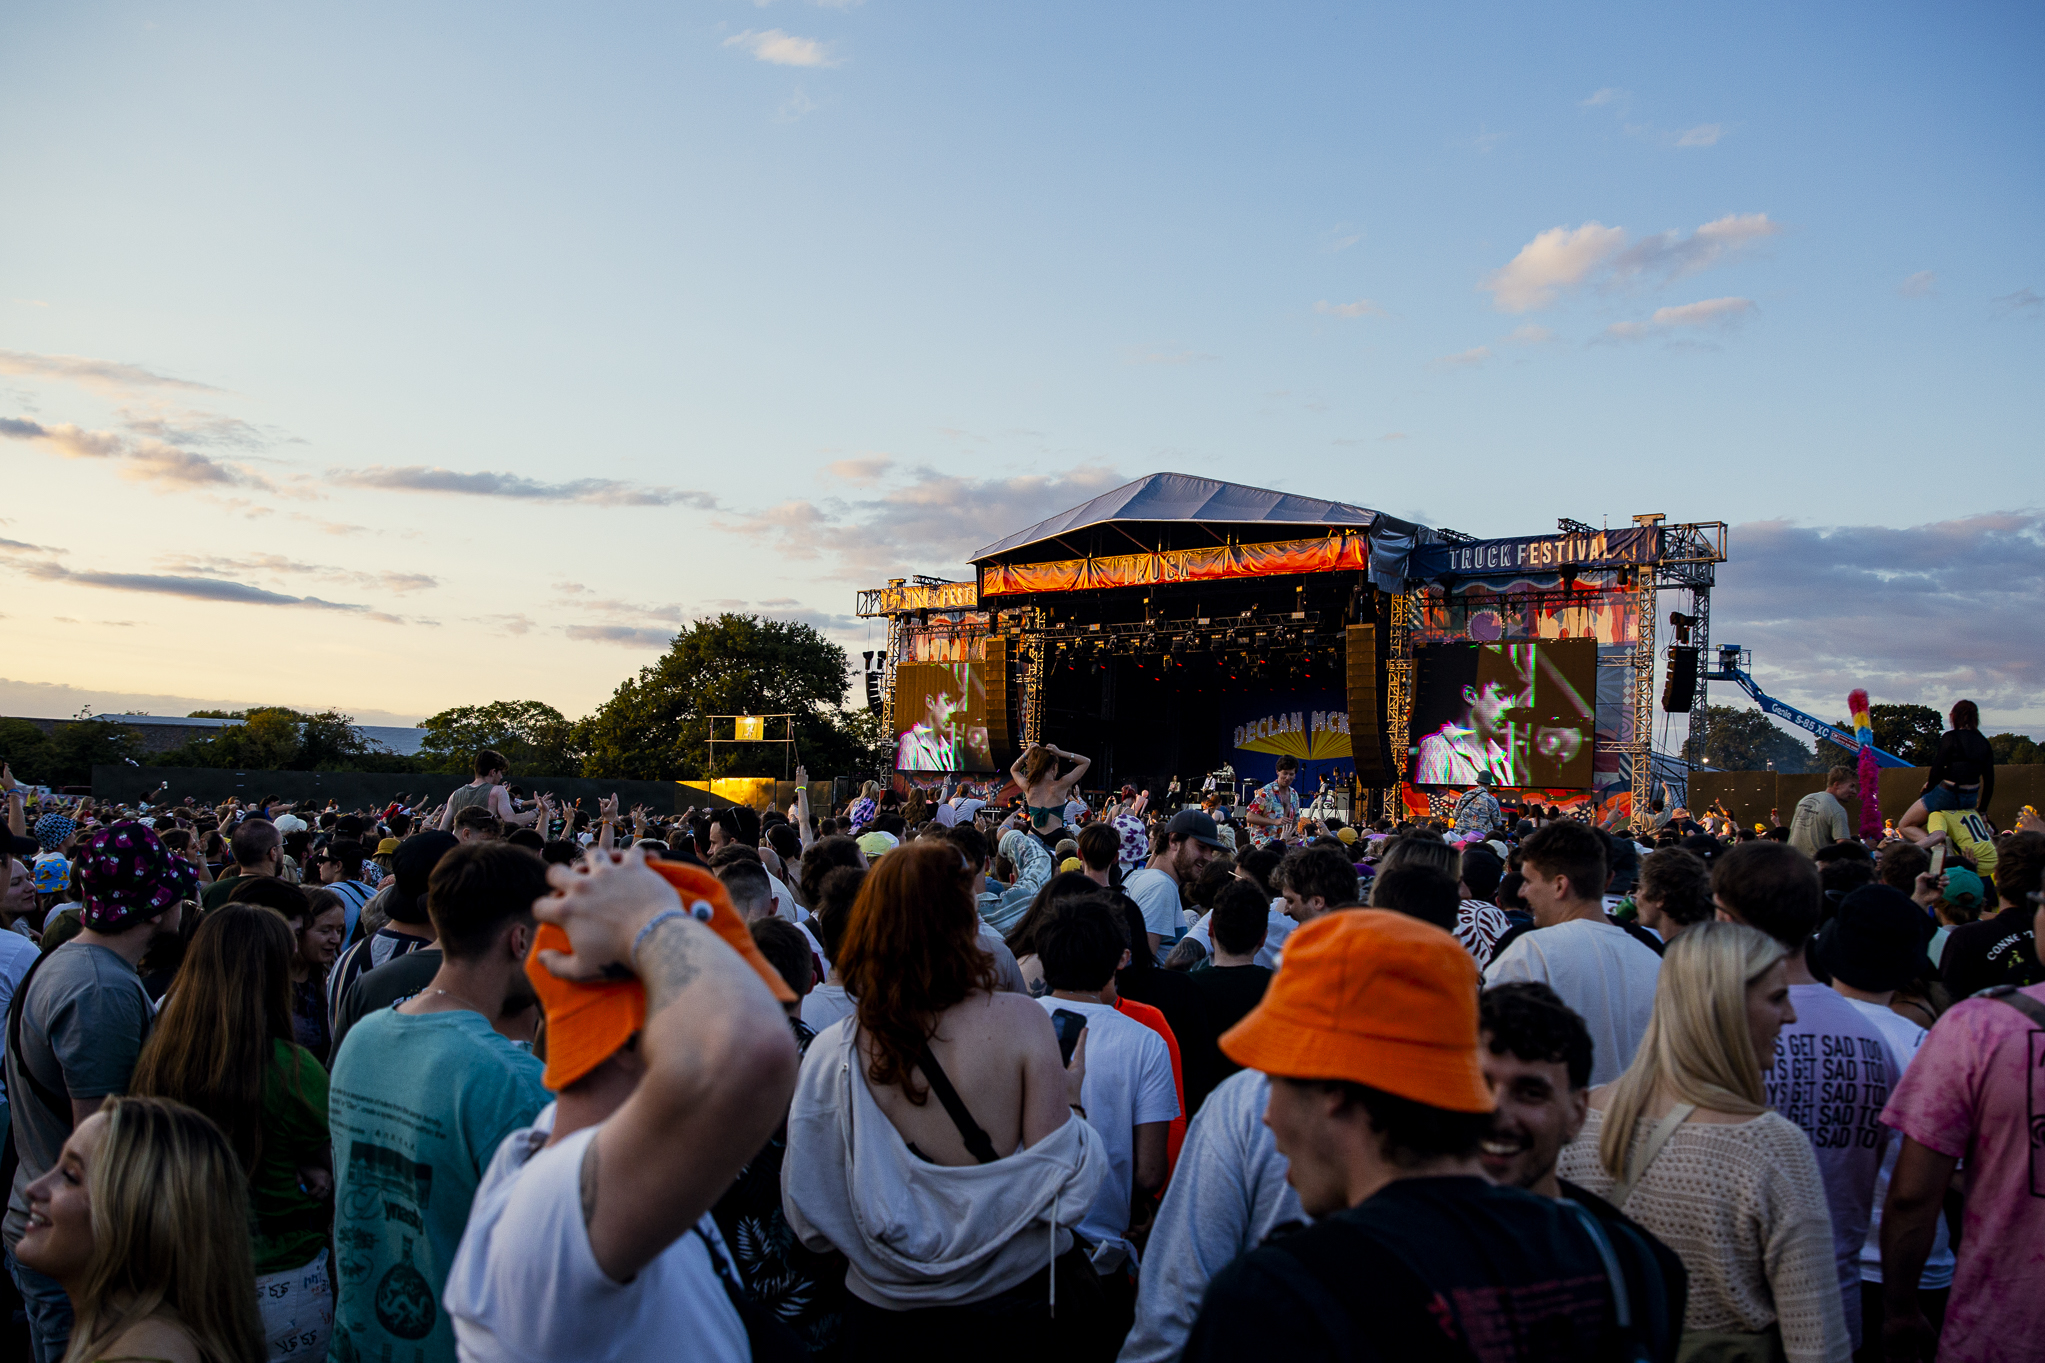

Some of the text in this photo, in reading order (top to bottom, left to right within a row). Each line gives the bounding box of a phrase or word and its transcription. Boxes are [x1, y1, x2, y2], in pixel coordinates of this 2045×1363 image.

[1450, 537, 1614, 570] TRUCK FESTIVAL
[1123, 552, 1191, 585] TRUCK
[1233, 711, 1303, 749] DECLAN
[1771, 702, 1830, 738] Genie S-85 XC
[1960, 813, 1991, 844] 10
[1788, 1034, 1816, 1057] GET
[1821, 1034, 1855, 1058] SAD
[1792, 1058, 1817, 1080] GET
[1822, 1058, 1857, 1081] SAD
[1791, 1081, 1817, 1104] GET
[1821, 1082, 1857, 1104] SAD
[1787, 1104, 1815, 1127] GET
[1818, 1105, 1855, 1126] SAD
[1815, 1127, 1851, 1149] SAD
